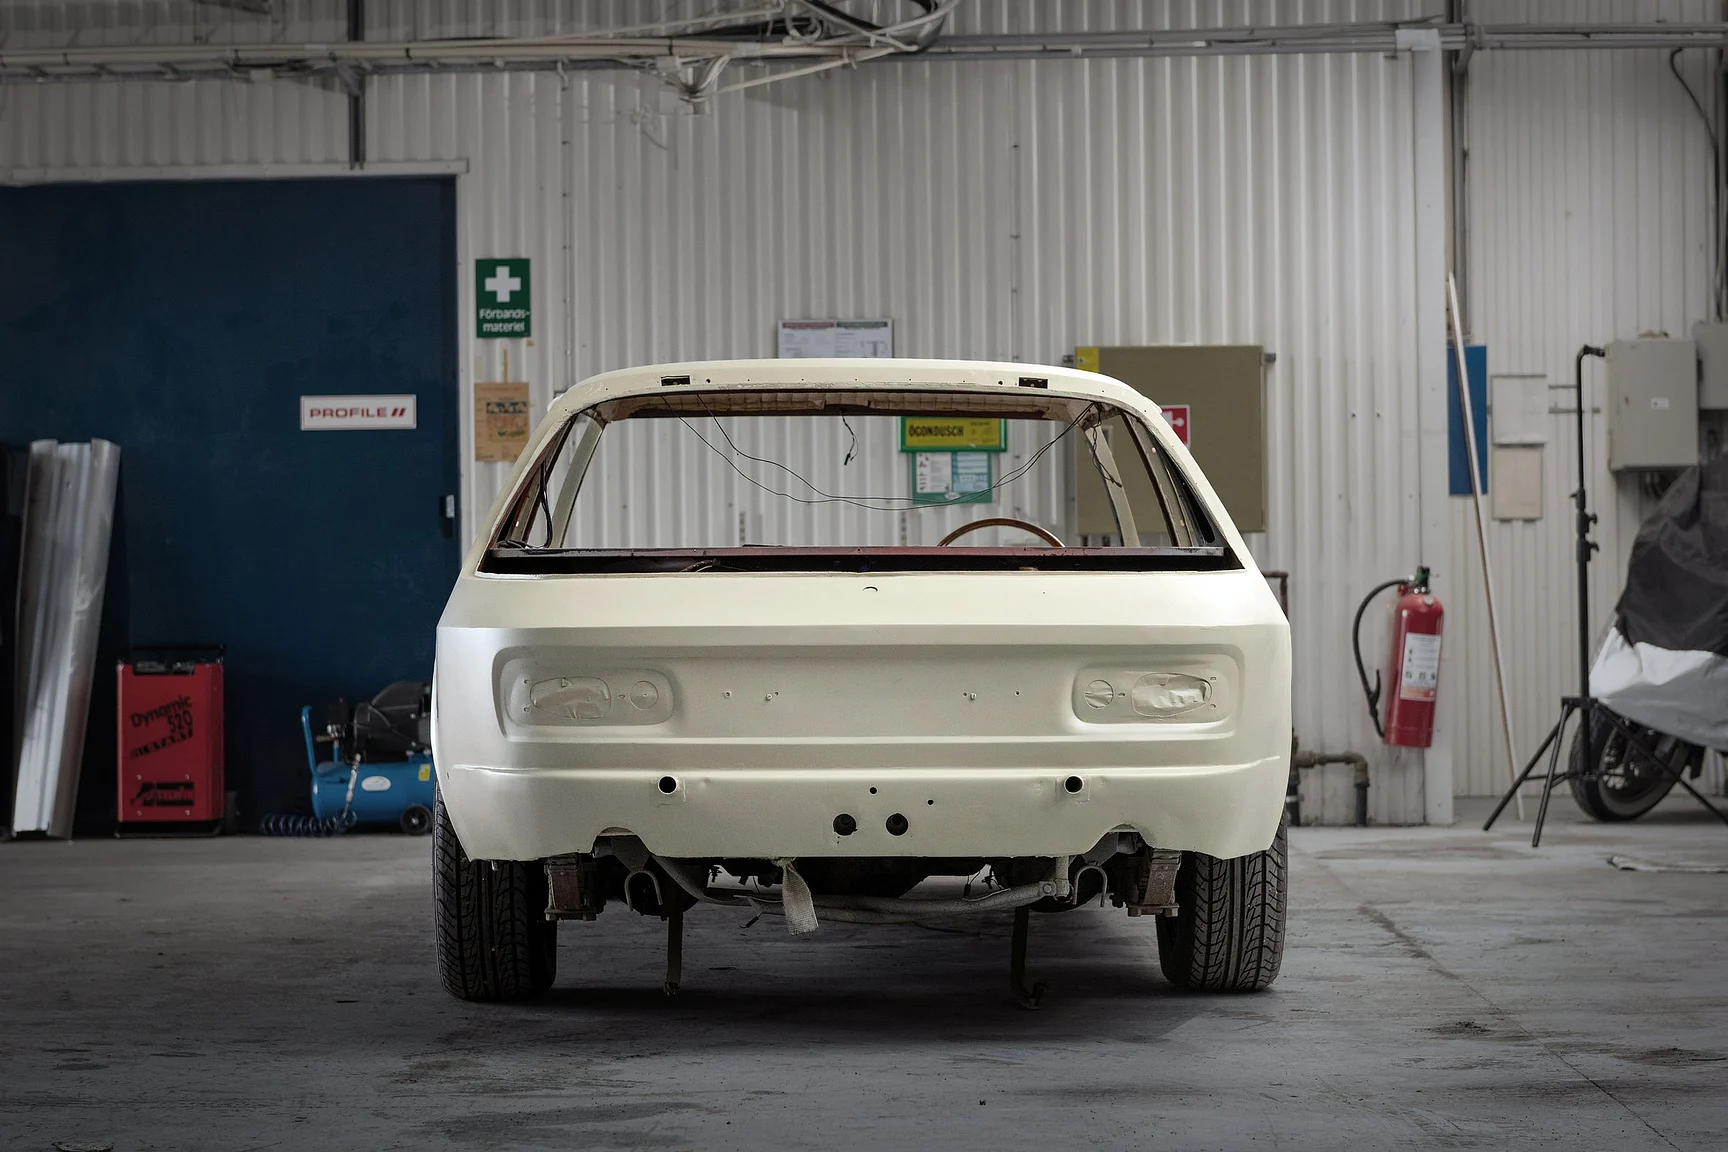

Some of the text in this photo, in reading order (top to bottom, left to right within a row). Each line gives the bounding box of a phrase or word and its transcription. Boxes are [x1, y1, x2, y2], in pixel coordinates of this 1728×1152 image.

[480, 308, 531, 320] Förbands-
[483, 321, 525, 333] materiel
[310, 408, 387, 418] PROFILE
[130, 694, 193, 729] Dynamic
